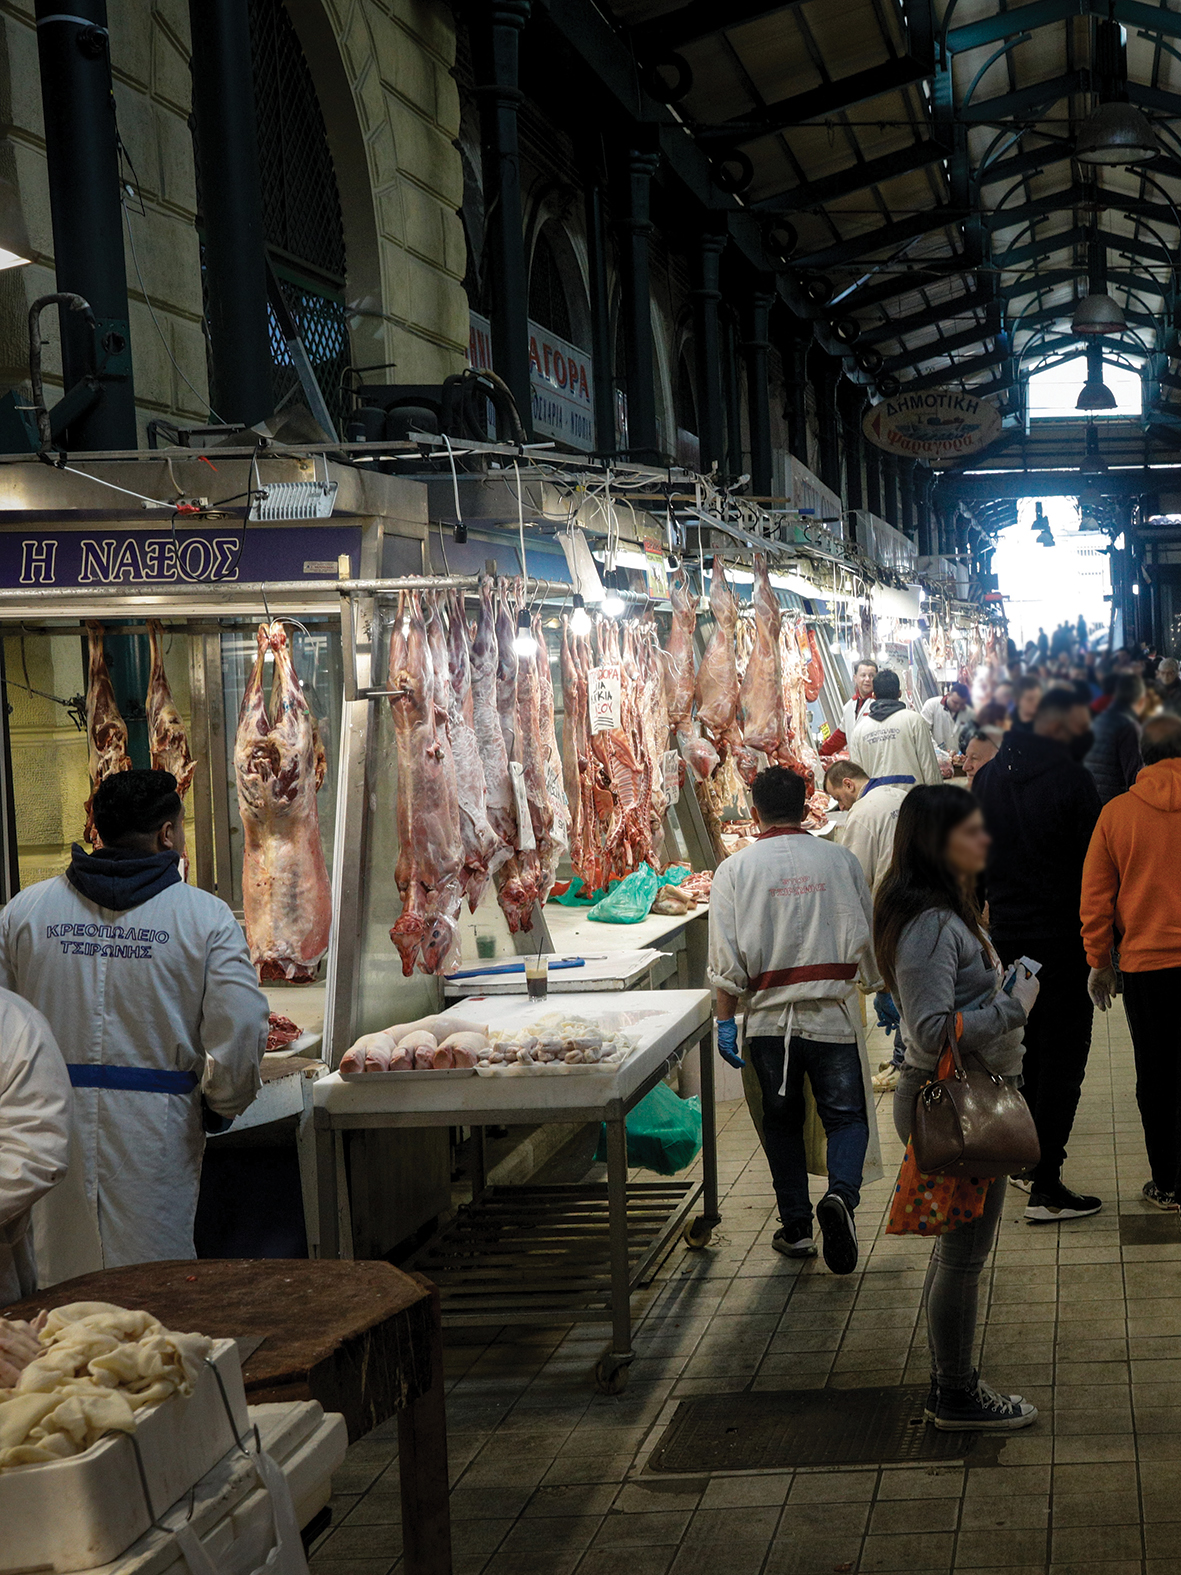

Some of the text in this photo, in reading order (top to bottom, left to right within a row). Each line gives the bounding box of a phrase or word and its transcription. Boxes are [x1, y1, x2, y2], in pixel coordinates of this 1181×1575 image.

[529, 336, 590, 402] ΑΓΟΡΑ
[886, 394, 979, 417] ΔΗΜΟΤΙΚΗ
[19, 537, 240, 583] Η ΝΑΞΟΣ
[46, 923, 170, 945] ΚΡΕΟΠΩΛΕΙΟ
[60, 941, 153, 959] ΤΣΙΡΩΝΗΣ
